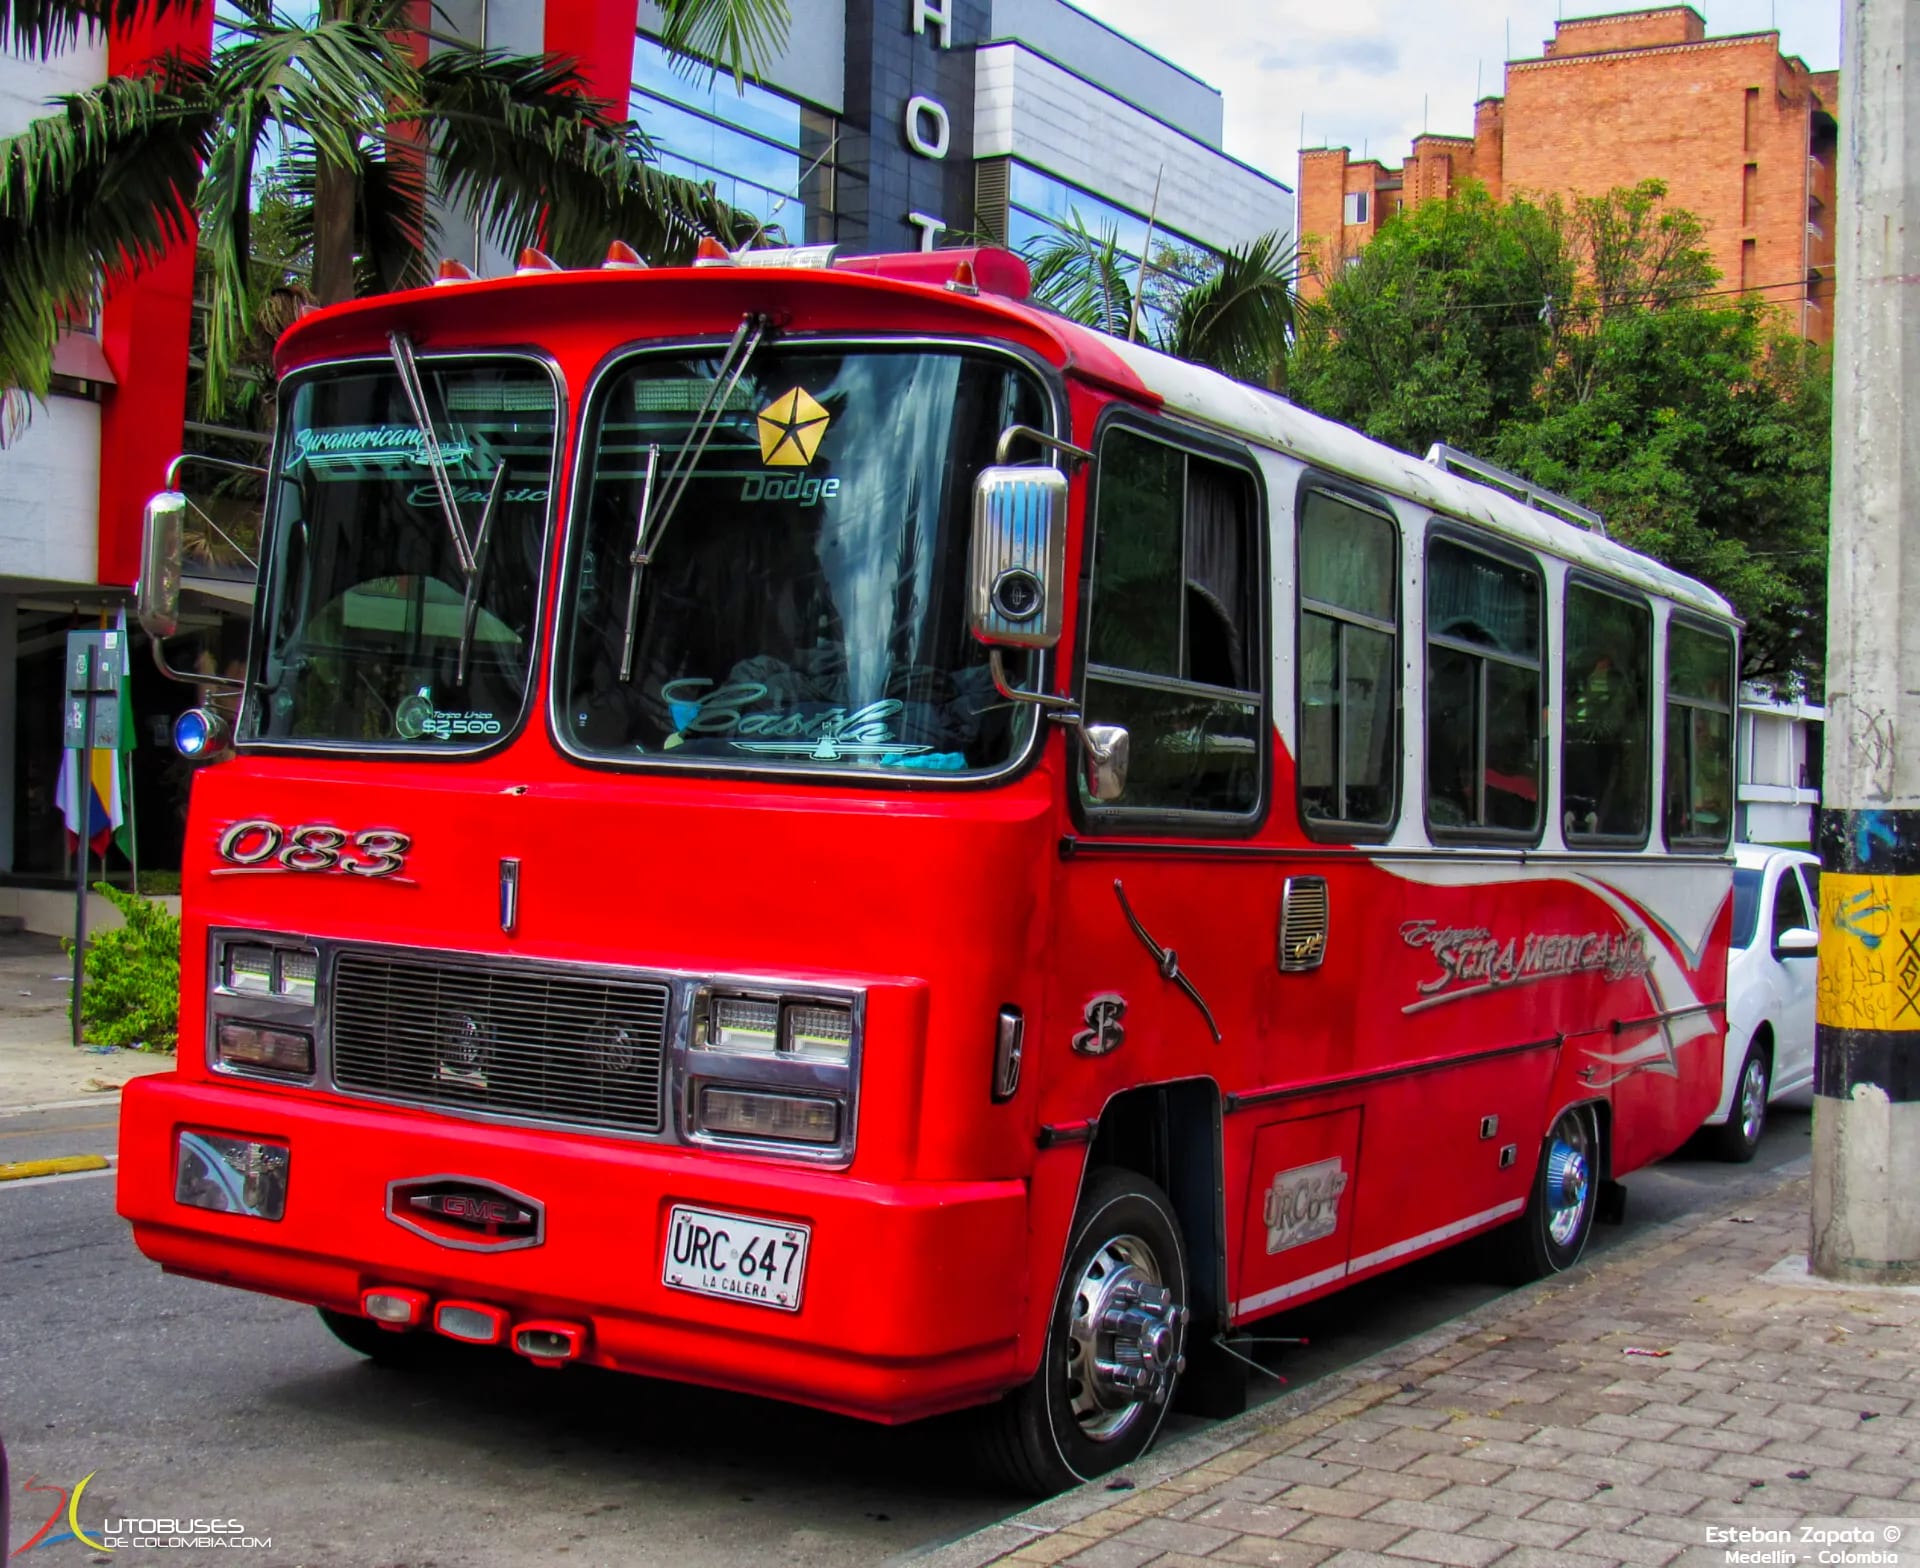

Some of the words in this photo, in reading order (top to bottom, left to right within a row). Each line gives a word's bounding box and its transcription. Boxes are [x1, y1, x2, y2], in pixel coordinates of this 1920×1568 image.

[741, 471, 840, 507] Dodge
[422, 719, 501, 734] $2.500
[218, 818, 411, 877] 083
[443, 1196, 507, 1223] GMC
[673, 1221, 730, 1272] URC
[738, 1236, 800, 1285] 647
[702, 1274, 717, 1288] LA
[721, 1277, 768, 1298] CALERA
